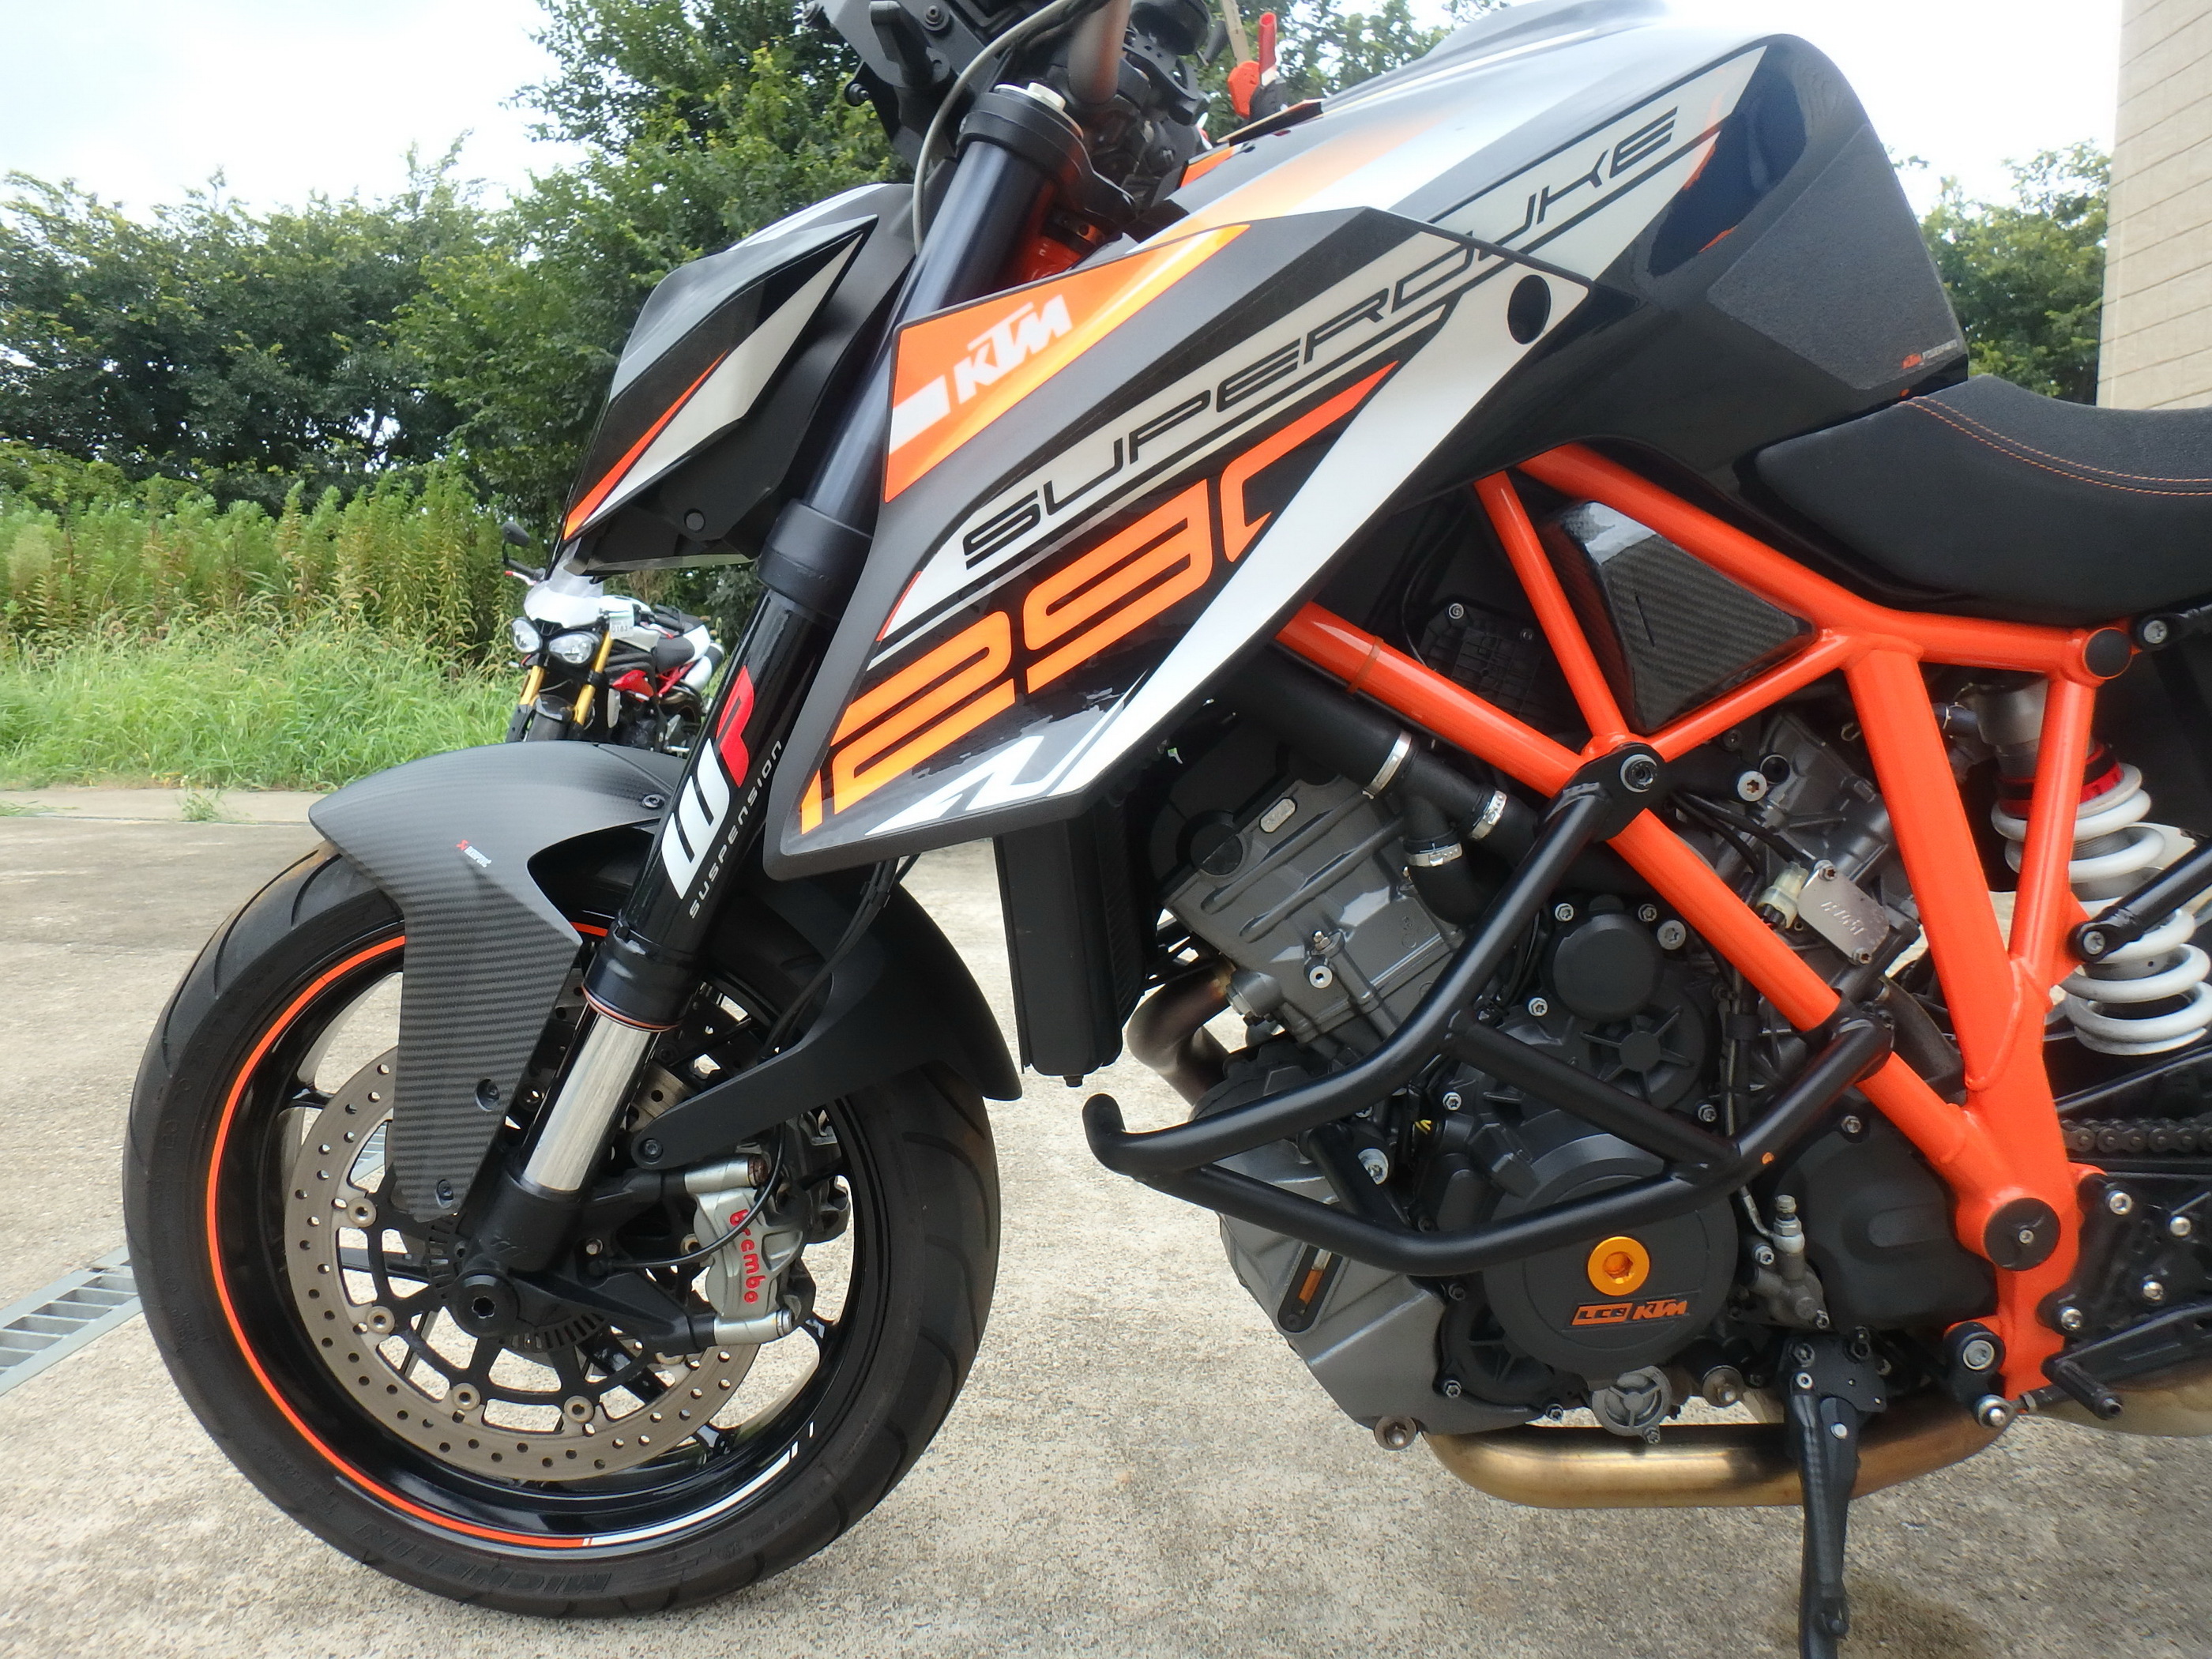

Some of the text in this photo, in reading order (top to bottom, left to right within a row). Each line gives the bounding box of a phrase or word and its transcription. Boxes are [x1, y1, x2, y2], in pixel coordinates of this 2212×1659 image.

[953, 295, 1073, 404] KTM
[689, 740, 782, 919] SUSPENSION
[1631, 1299, 1687, 1320] KTM
